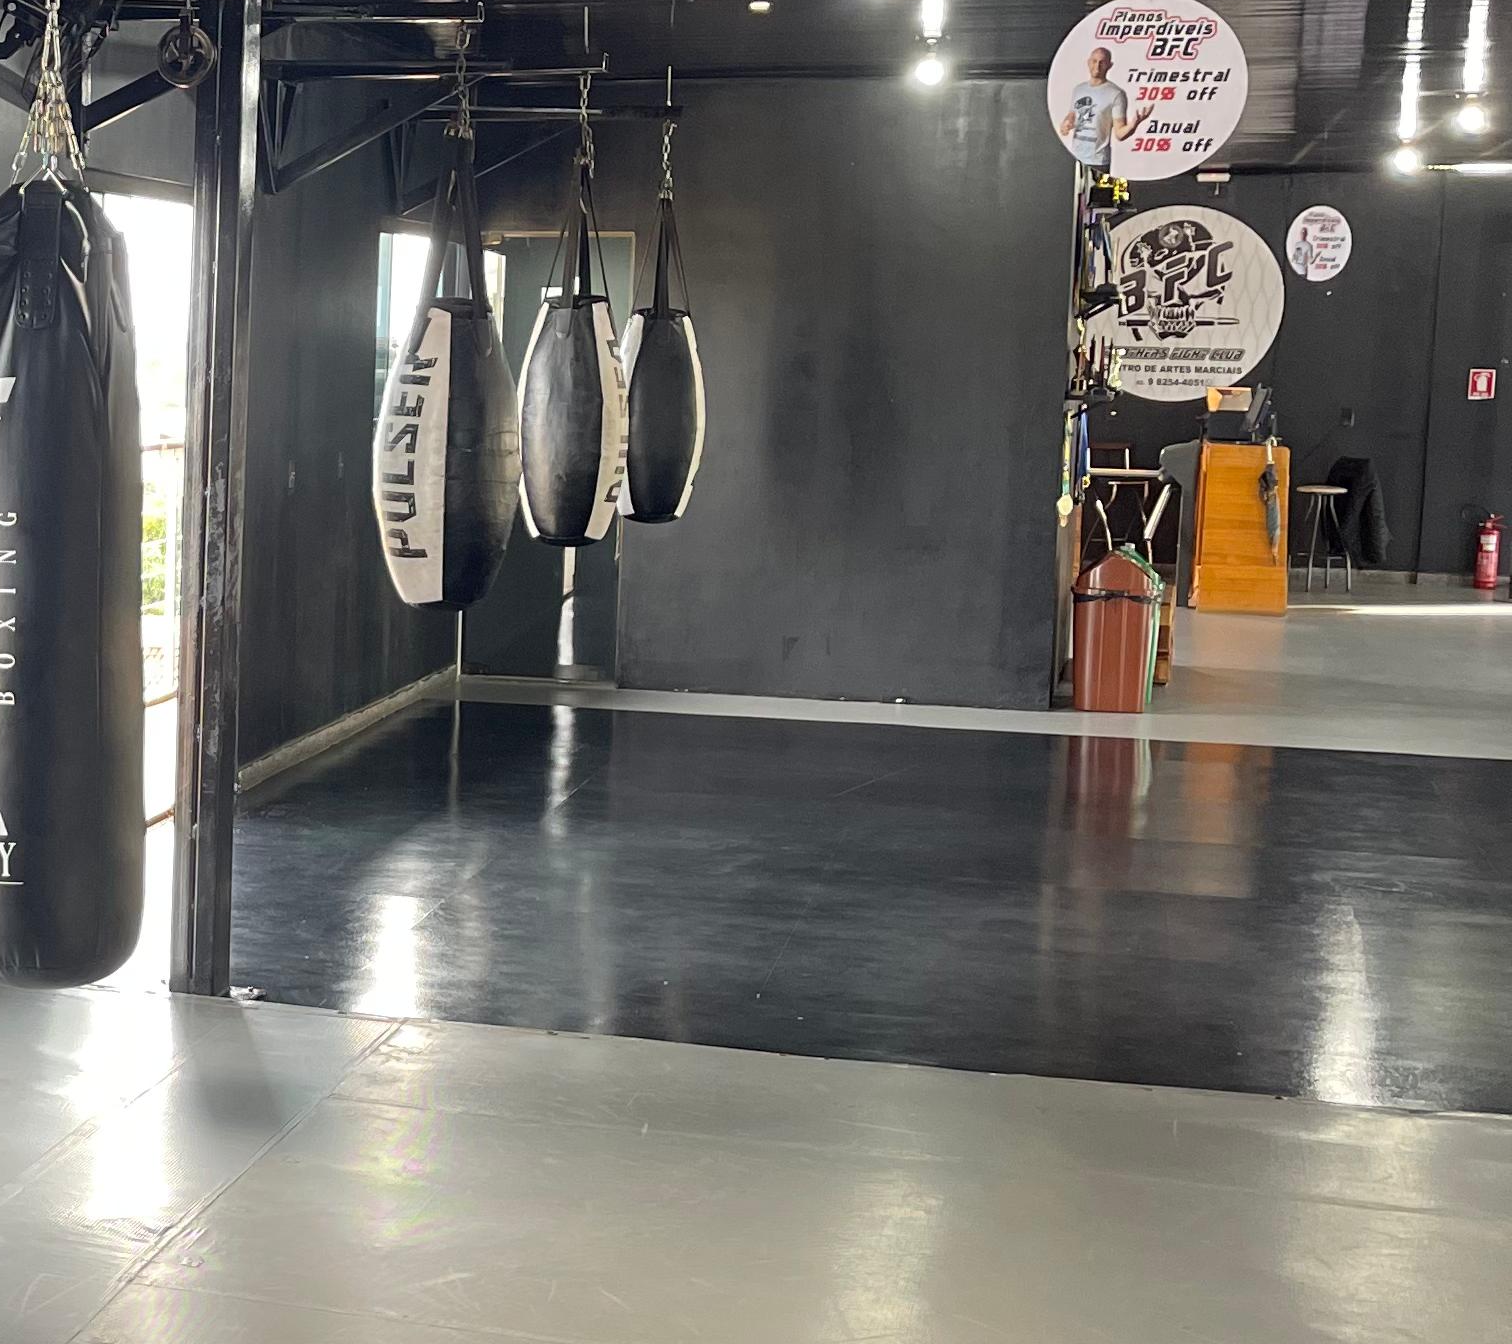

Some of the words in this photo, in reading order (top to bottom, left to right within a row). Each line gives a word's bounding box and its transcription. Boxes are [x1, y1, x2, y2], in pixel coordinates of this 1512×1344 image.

[1114, 12, 1163, 22] Planos
[1100, 20, 1213, 39] Imperdíveis
[1151, 38, 1199, 56] BFC
[1127, 68, 1231, 82] Trimestral
[1136, 87, 1176, 100] 30%
[1187, 87, 1218, 100] off
[1146, 120, 1200, 134] Anual
[1131, 138, 1172, 152] 30%
[1182, 138, 1213, 152] off
[1144, 365, 1157, 373] DE
[1160, 365, 1192, 373] ARTES
[1194, 366, 1243, 375] MARCIAIS
